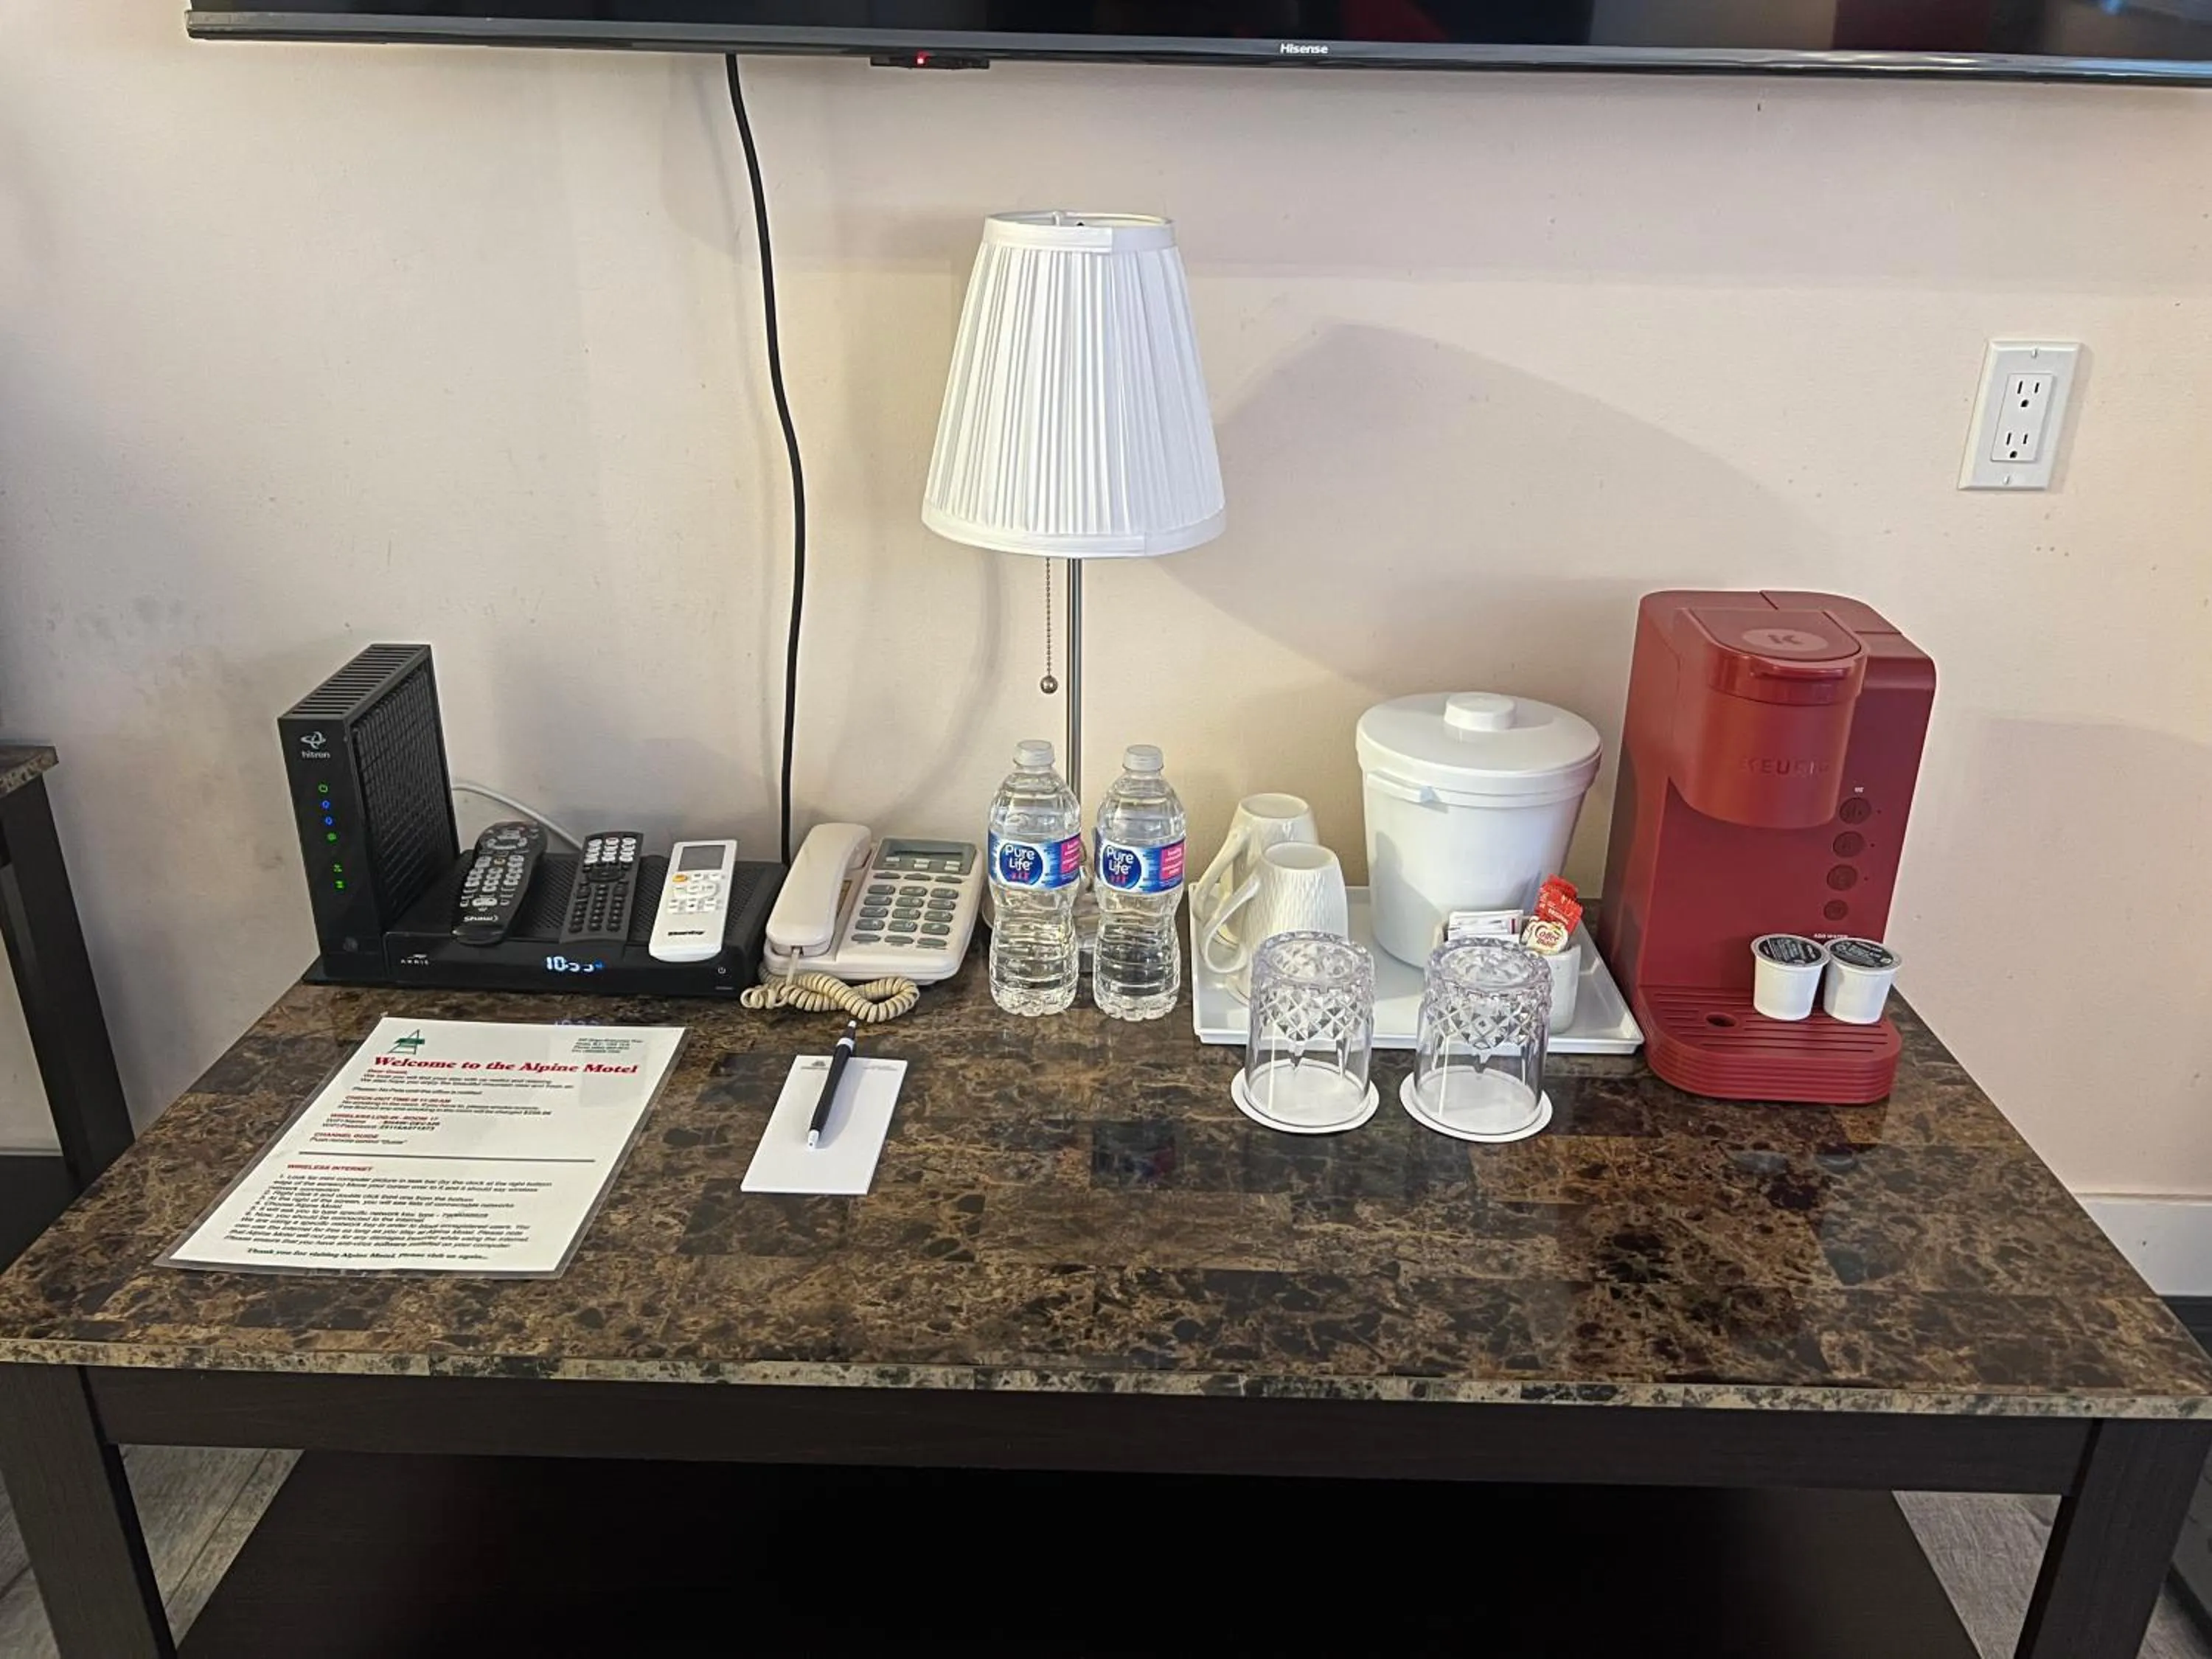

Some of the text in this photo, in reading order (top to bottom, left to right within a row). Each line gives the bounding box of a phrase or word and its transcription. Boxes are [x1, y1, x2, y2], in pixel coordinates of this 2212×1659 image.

[1280, 43, 1329, 54] Hisense
[1005, 844, 1035, 860] Pure
[1107, 846, 1134, 864] Pure
[1009, 857, 1031, 871] Life
[1108, 859, 1130, 875] Life
[375, 1057, 639, 1074] Welcome to the Alpine Motel
